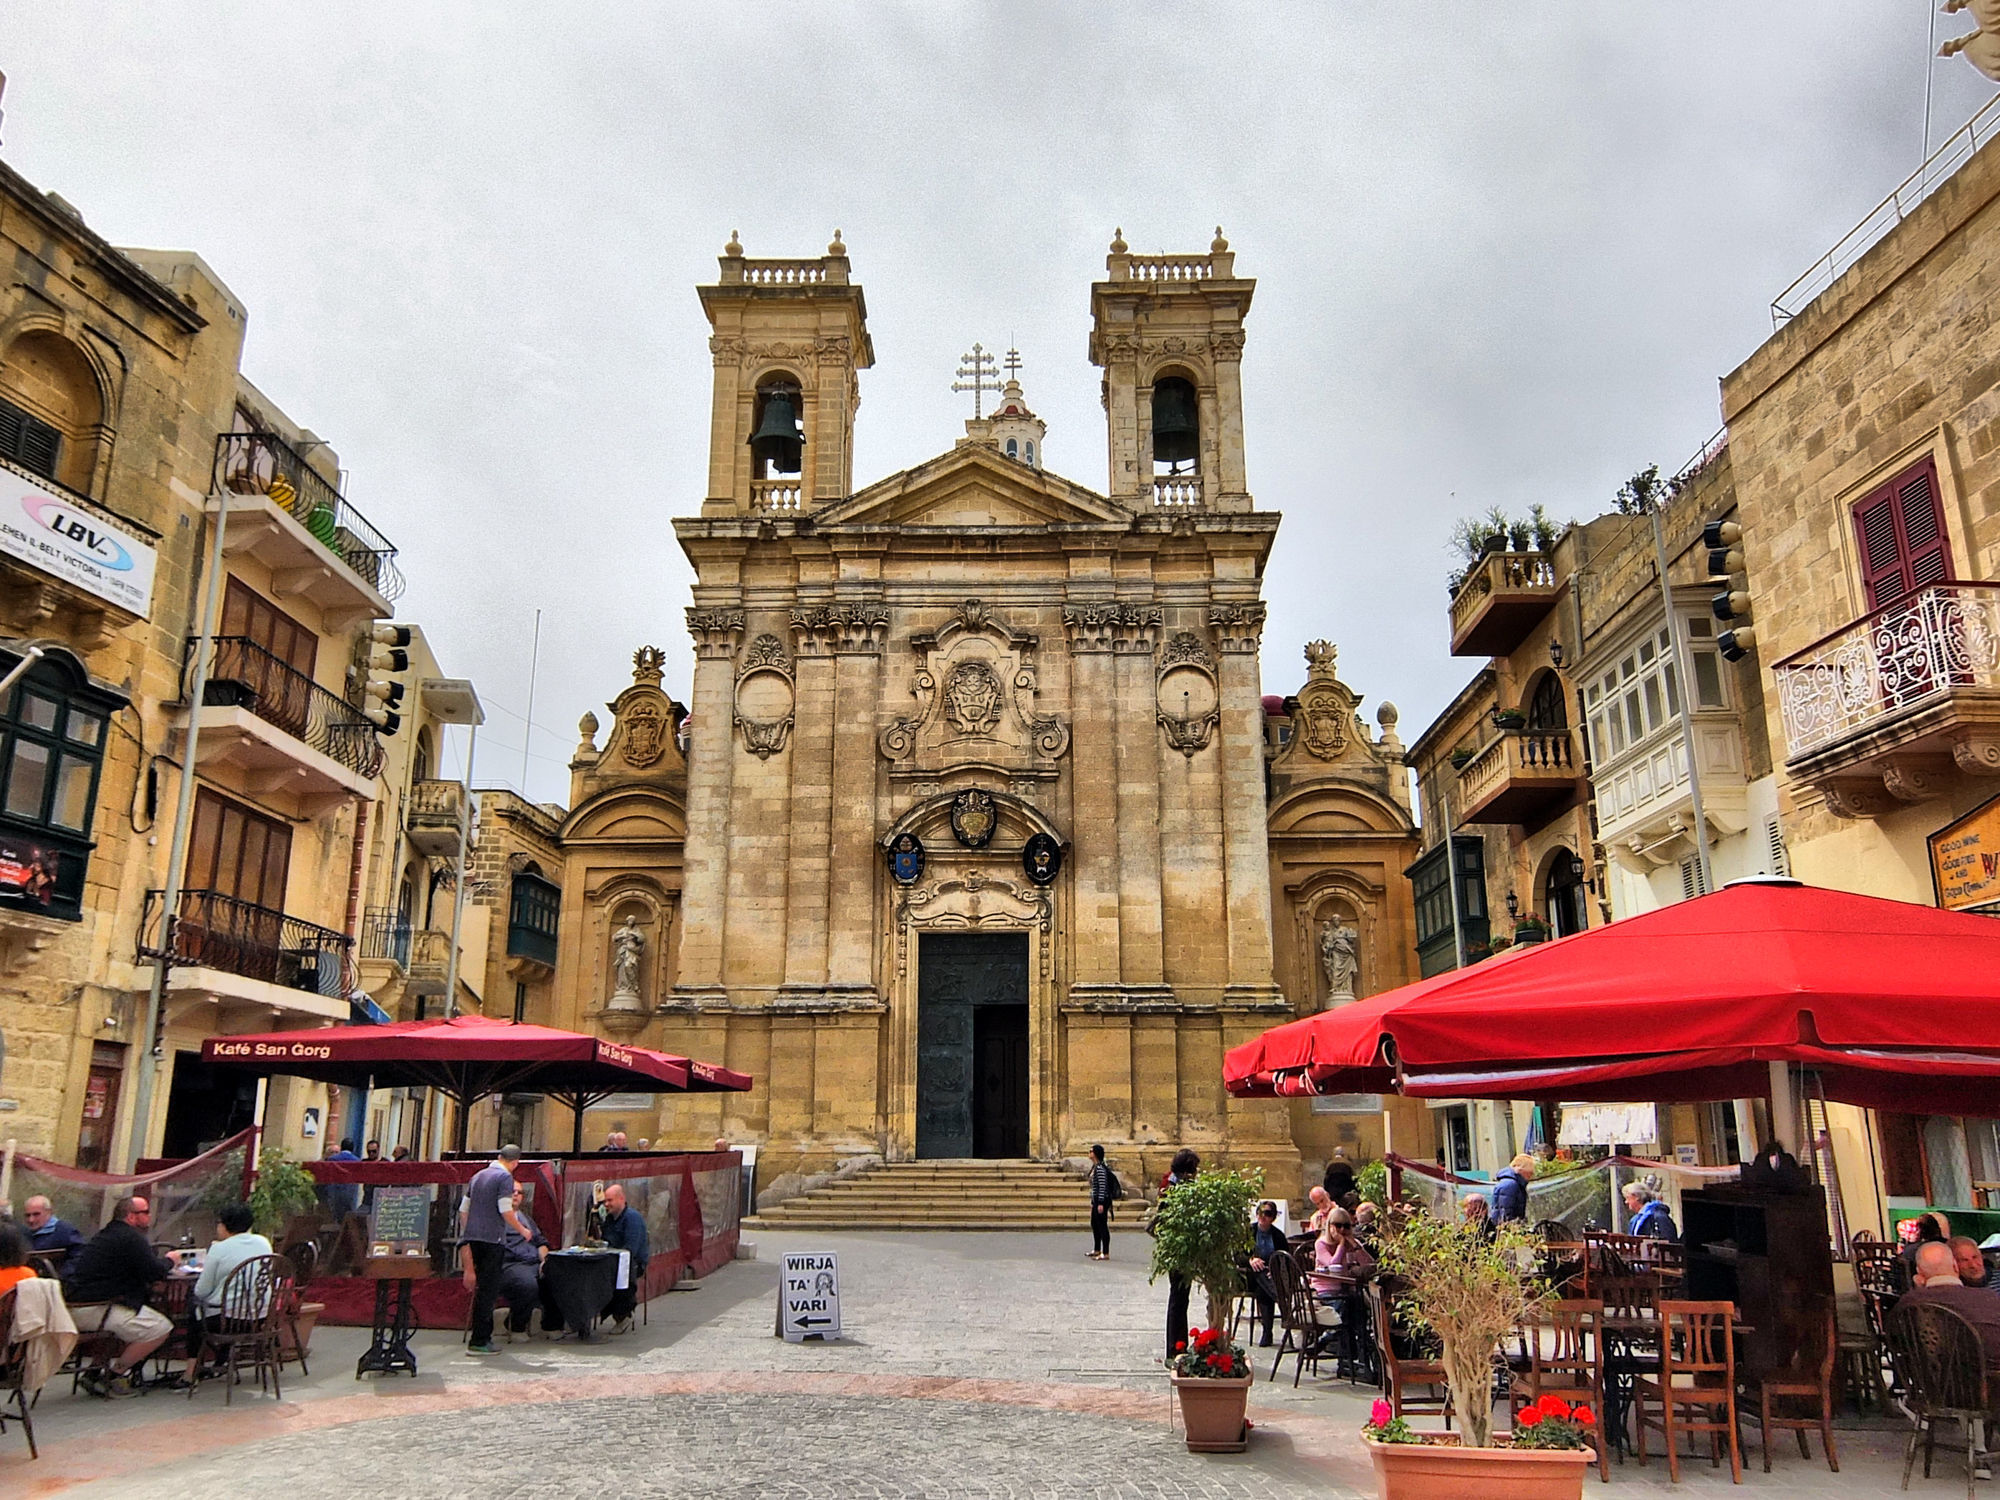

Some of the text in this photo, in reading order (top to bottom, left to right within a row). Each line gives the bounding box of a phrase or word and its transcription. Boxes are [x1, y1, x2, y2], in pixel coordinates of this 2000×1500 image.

[52, 514, 106, 549] LBV
[63, 553, 102, 578] VICTORIA
[213, 1041, 251, 1056] Kafé
[255, 1043, 287, 1056] San
[787, 1257, 834, 1270] WIRJA
[788, 1279, 810, 1291] TA'
[789, 1299, 827, 1312] VARI
